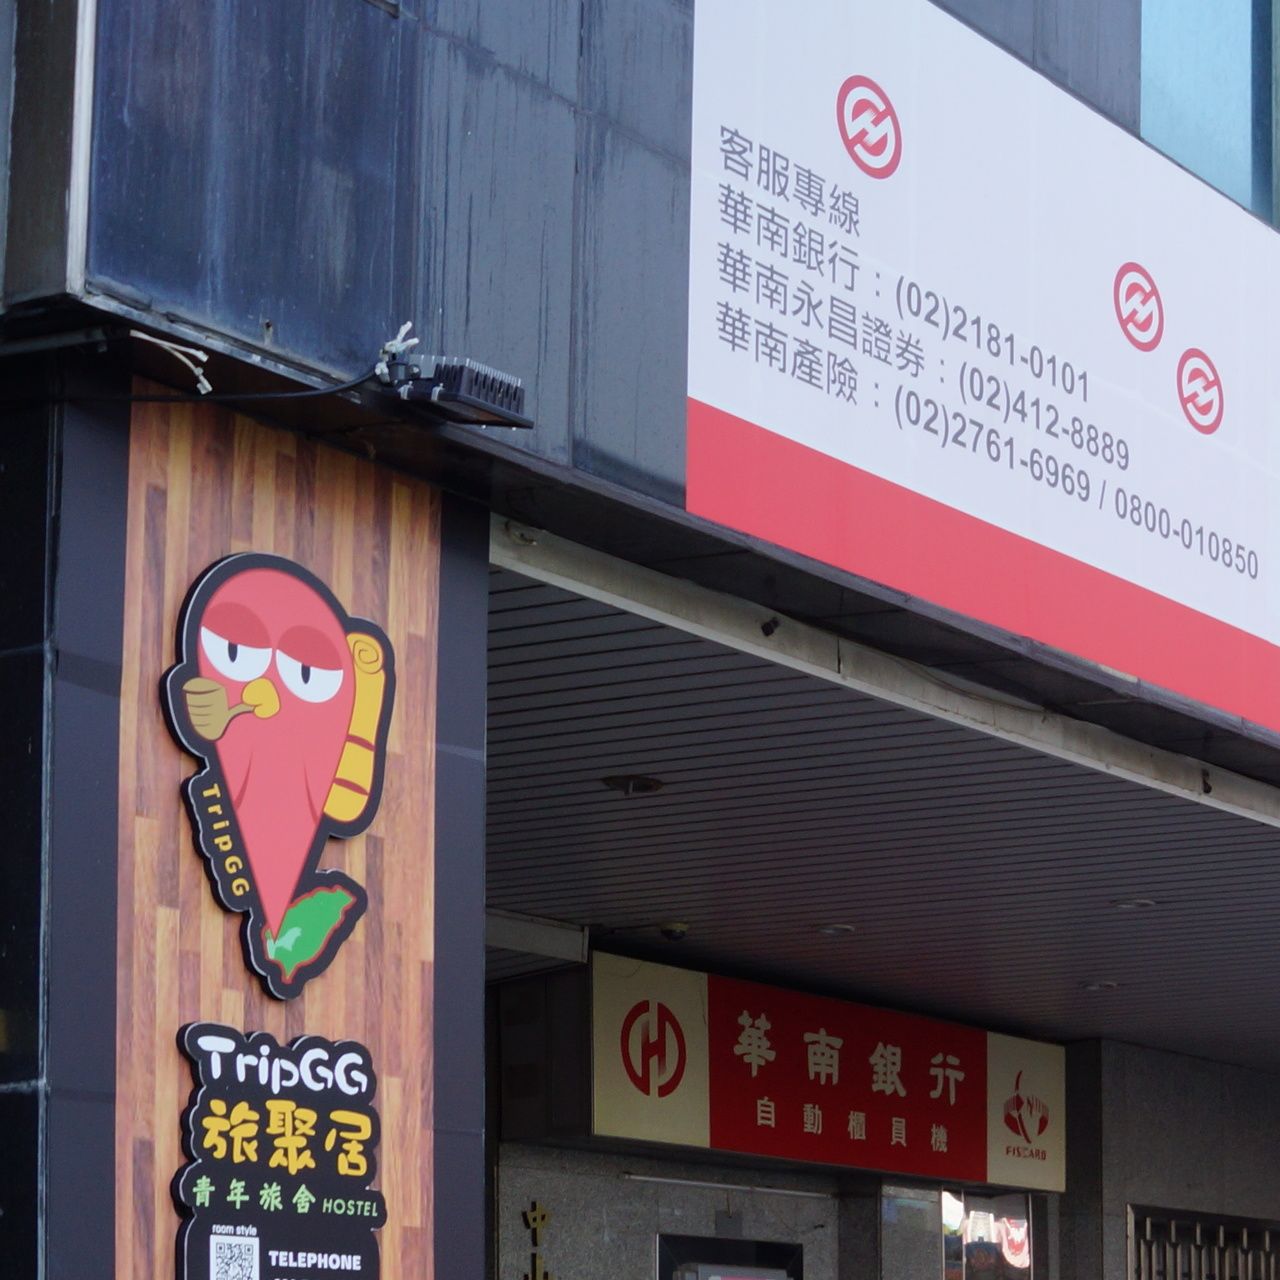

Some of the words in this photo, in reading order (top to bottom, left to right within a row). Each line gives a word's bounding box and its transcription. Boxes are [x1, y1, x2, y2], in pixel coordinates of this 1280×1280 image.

[719, 124, 861, 238] 客服專線
[1114, 487, 1259, 580] 0800-010850
[199, 783, 251, 899] TripGG
[197, 1035, 369, 1096] TripGG
[733, 1009, 966, 1106] 華南銀行
[201, 1098, 372, 1177] 旅聚居
[756, 1096, 949, 1154] 自動櫃員機
[192, 1175, 317, 1214] 青年旅舍
[322, 1198, 379, 1217] HOSTEL
[212, 1224, 235, 1236] room
[235, 1224, 258, 1237] style
[268, 1250, 362, 1271] TELEPHONE
